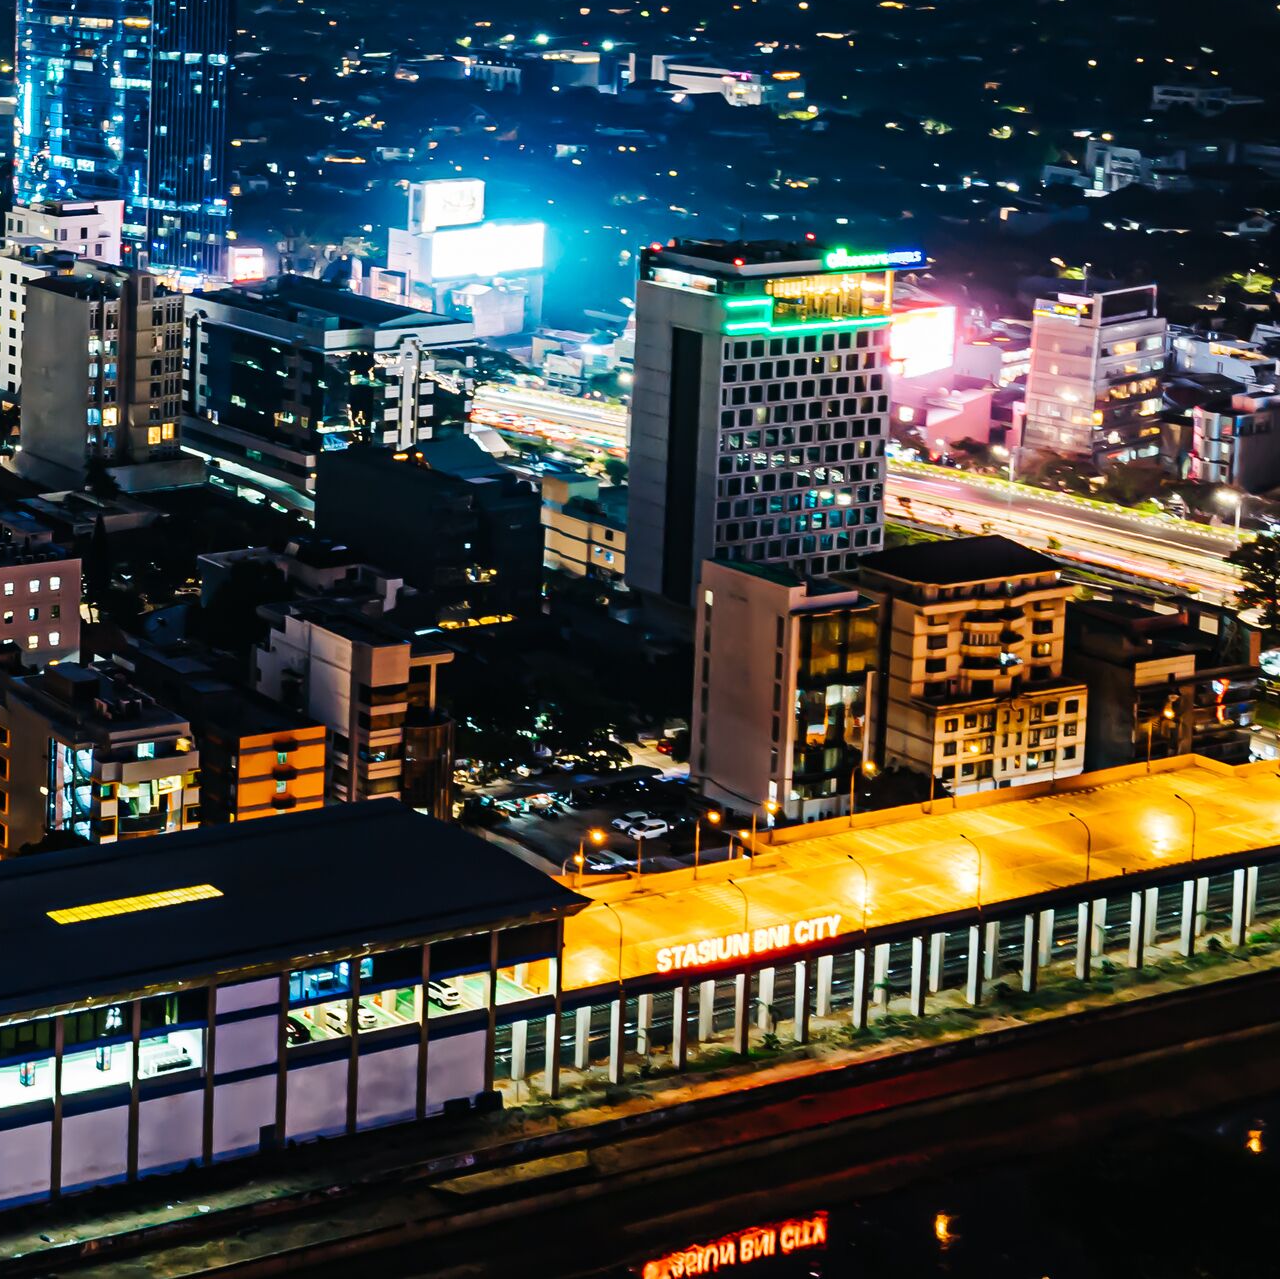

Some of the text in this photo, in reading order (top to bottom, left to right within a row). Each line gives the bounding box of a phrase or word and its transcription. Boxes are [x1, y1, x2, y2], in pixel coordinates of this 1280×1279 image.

[656, 914, 842, 972] STASIUN BNI CITY
